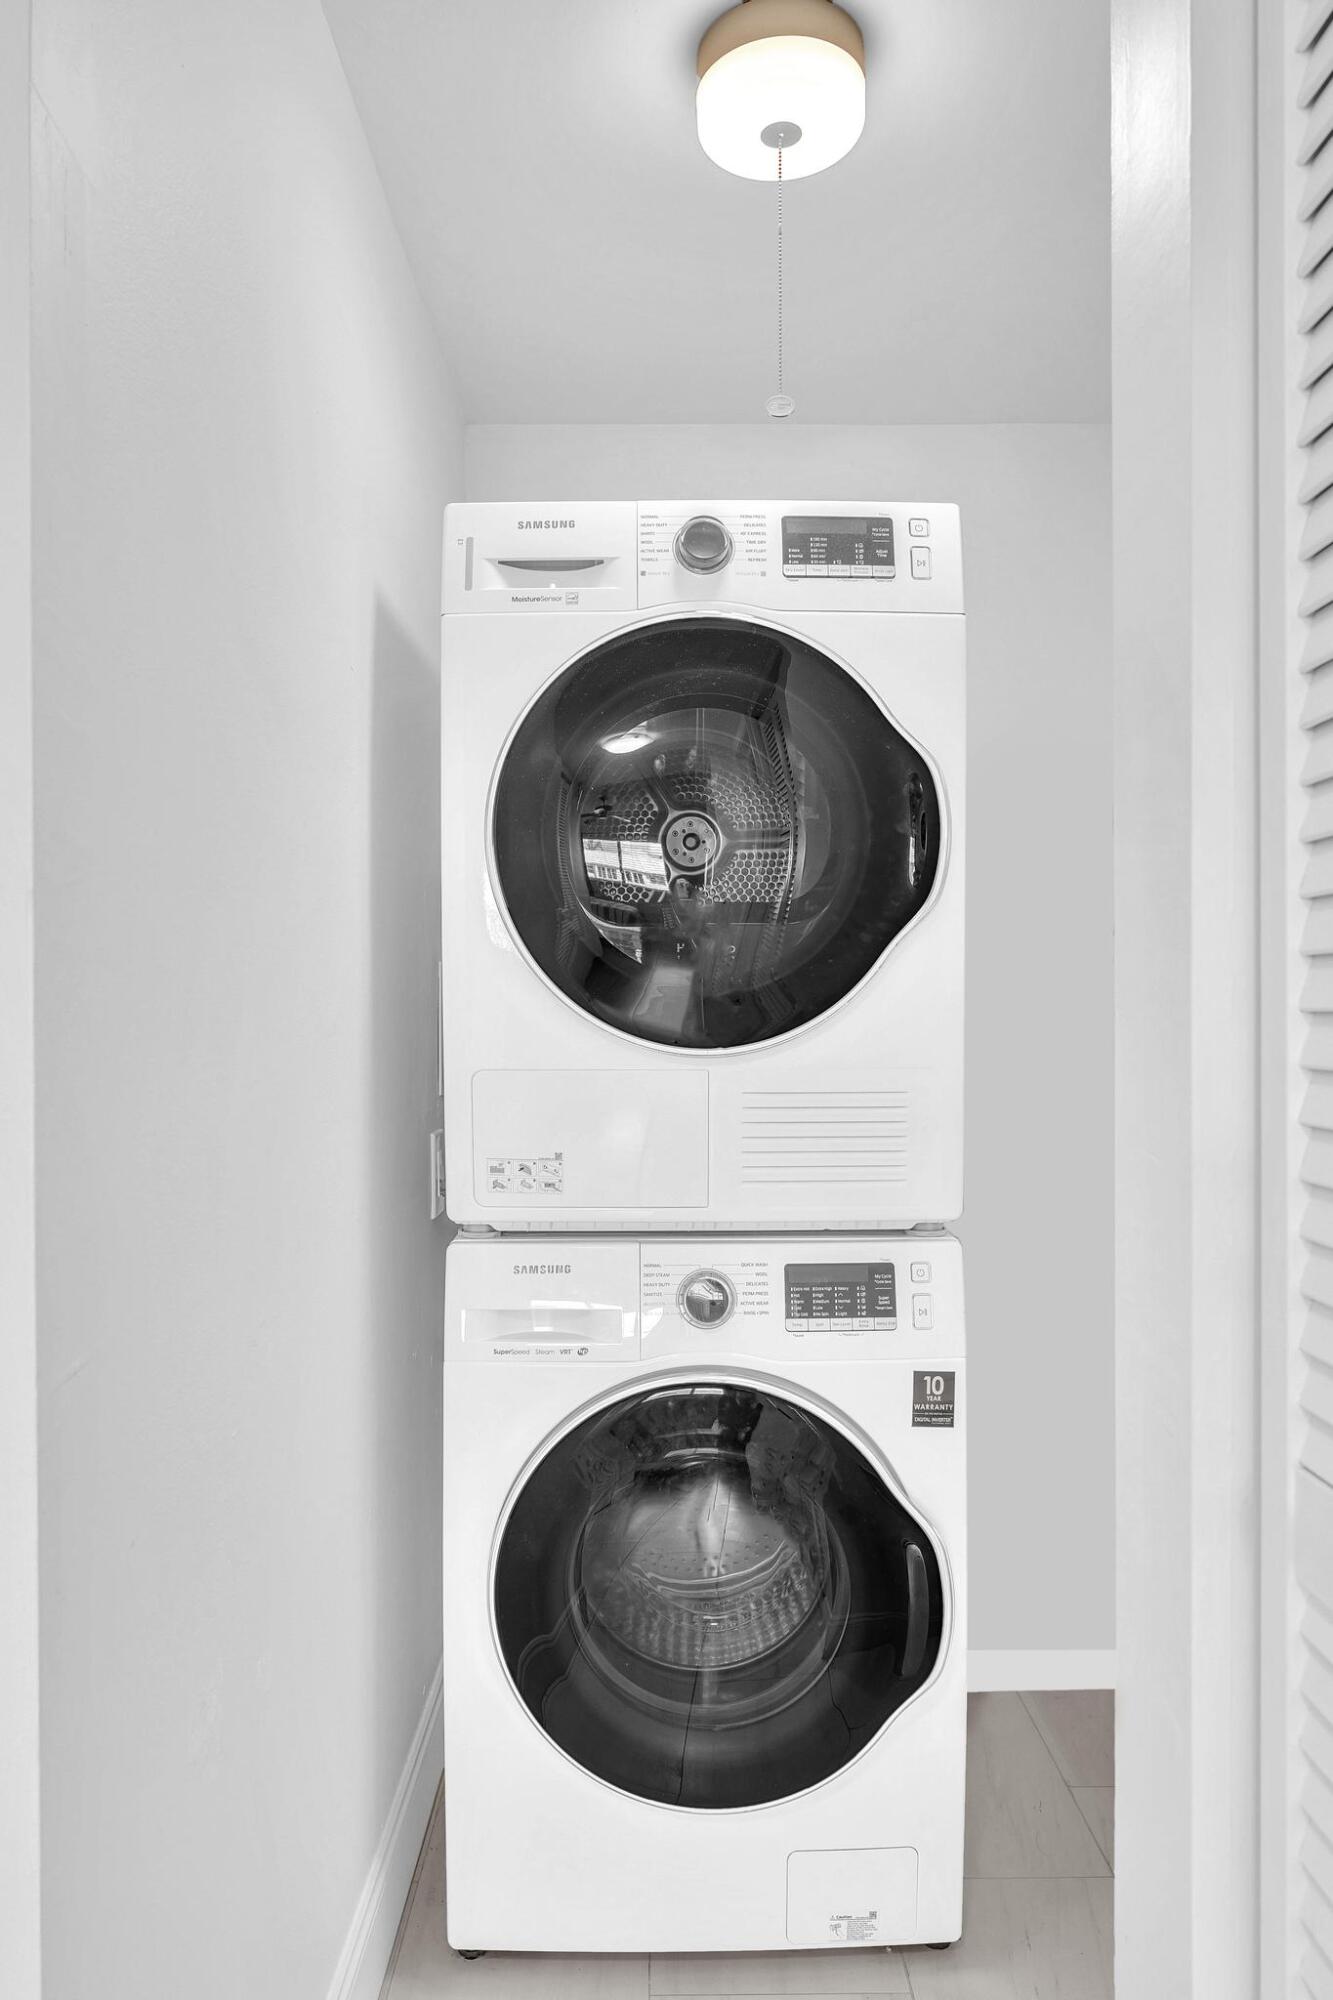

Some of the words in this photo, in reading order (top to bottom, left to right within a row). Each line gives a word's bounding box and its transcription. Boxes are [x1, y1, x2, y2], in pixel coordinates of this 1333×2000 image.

[517, 519, 576, 530] SAMSUNG
[513, 1264, 572, 1275] SAMSUNG
[923, 1375, 945, 1395] 10
[913, 1403, 954, 1411] WARRANTY
